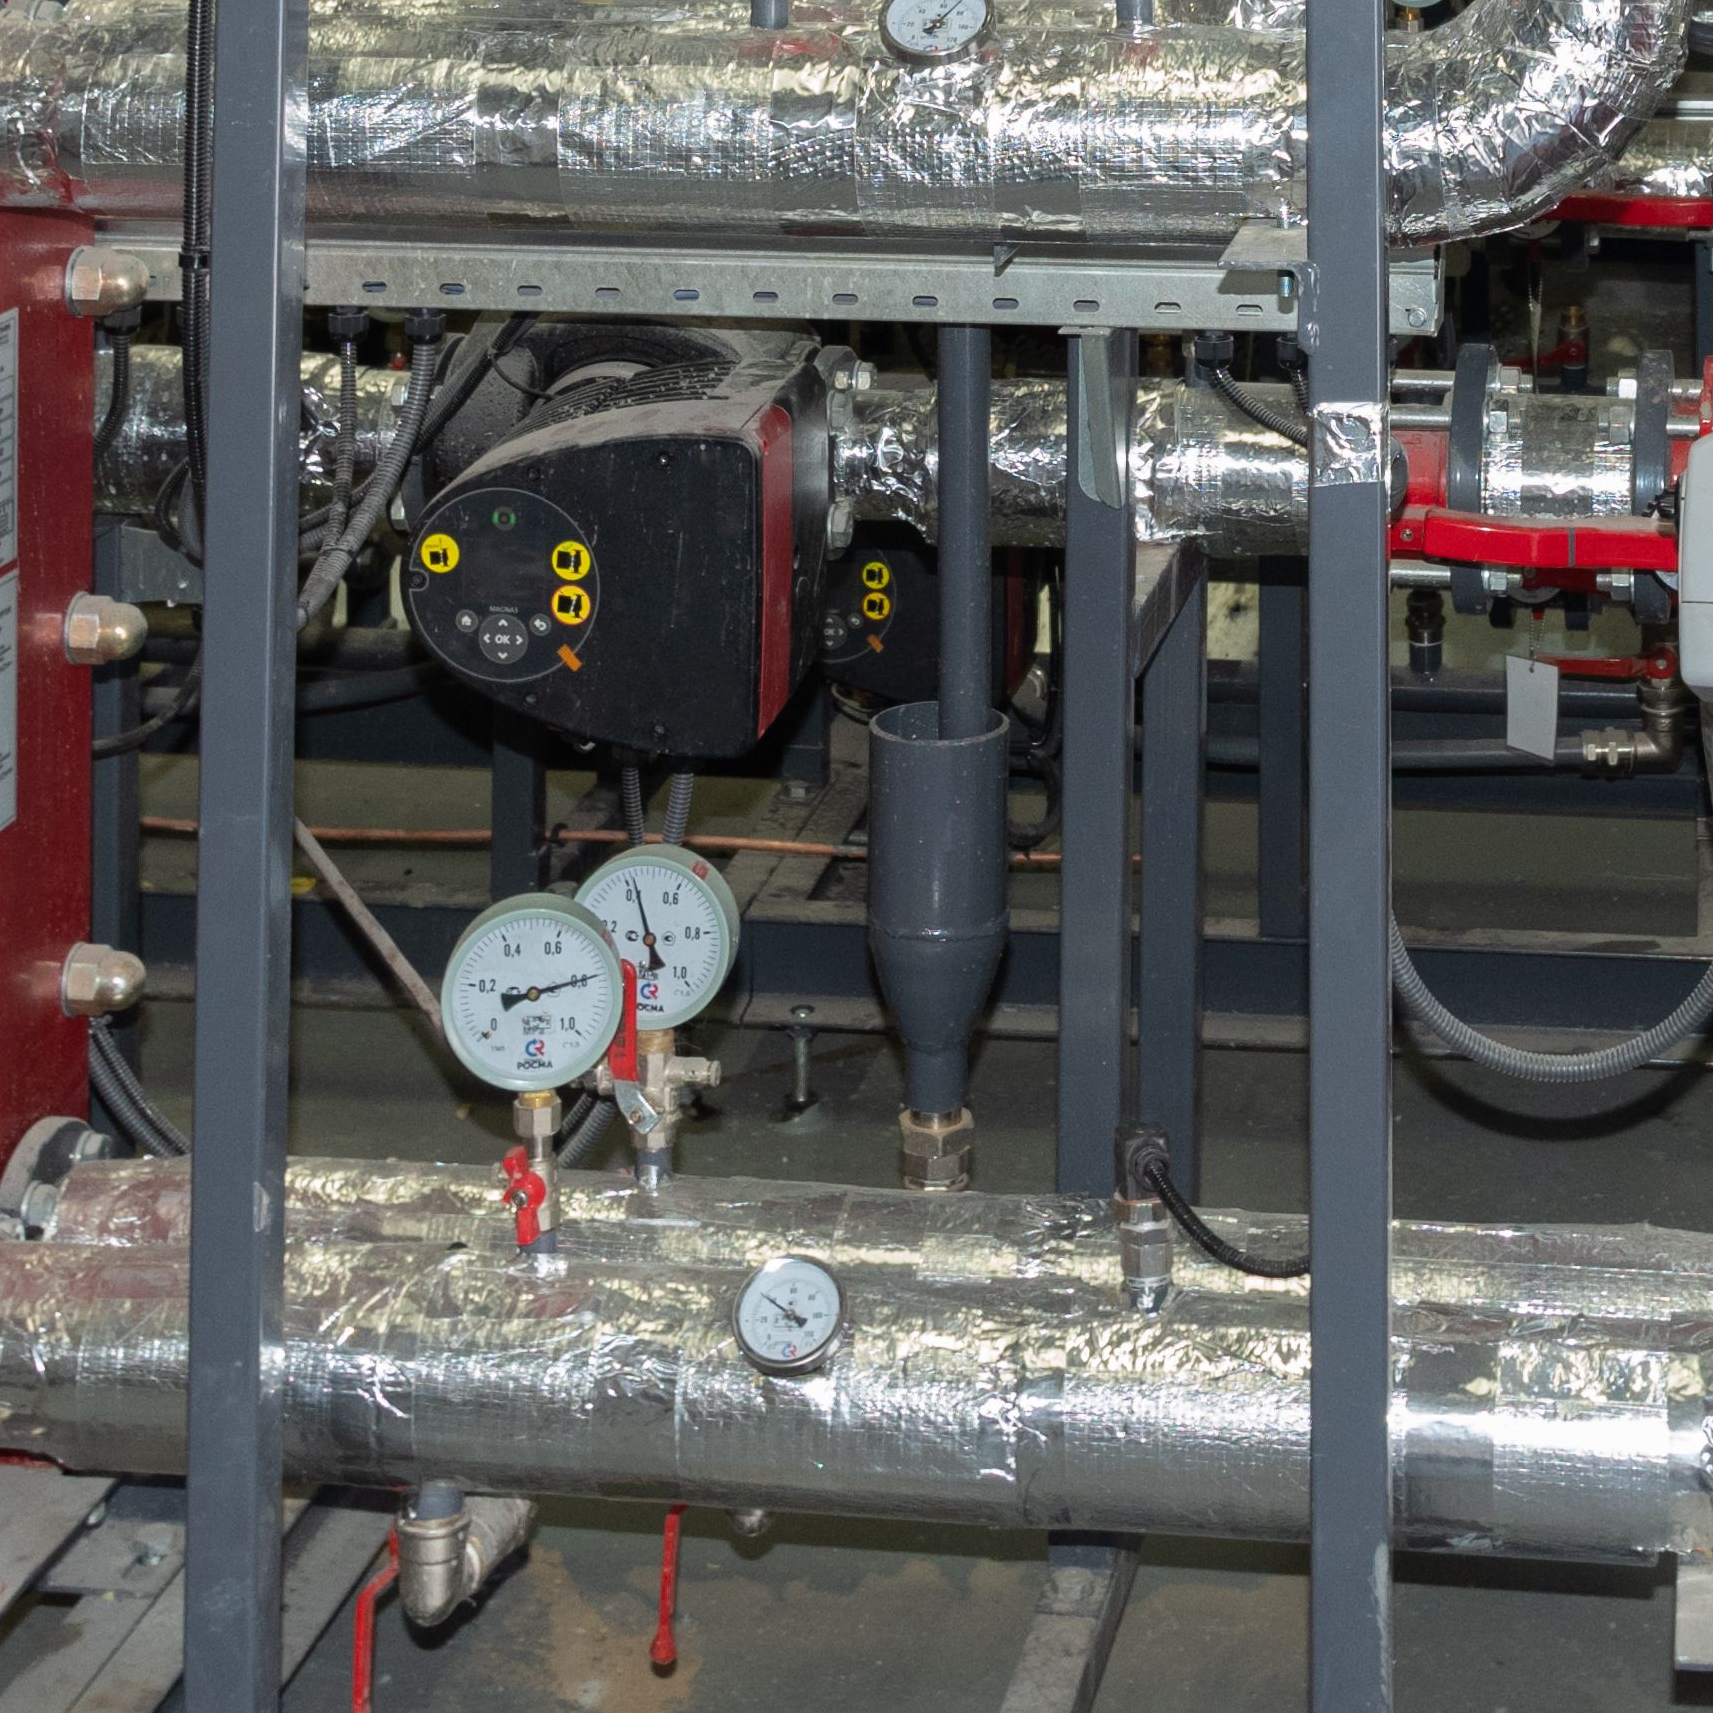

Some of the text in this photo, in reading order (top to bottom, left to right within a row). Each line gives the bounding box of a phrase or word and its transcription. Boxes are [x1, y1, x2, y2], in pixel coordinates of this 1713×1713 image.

[495, 634, 511, 645] OK
[662, 893, 679, 906] 0,6
[685, 927, 701, 941] 0,8
[504, 943, 521, 958] 0,4
[544, 941, 562, 956] 0,6
[673, 966, 687, 980] 1,0
[479, 979, 496, 994] 0,2
[637, 1003, 664, 1013] ОСМА
[490, 1018, 497, 1031] 0
[560, 1017, 575, 1032] 1,0
